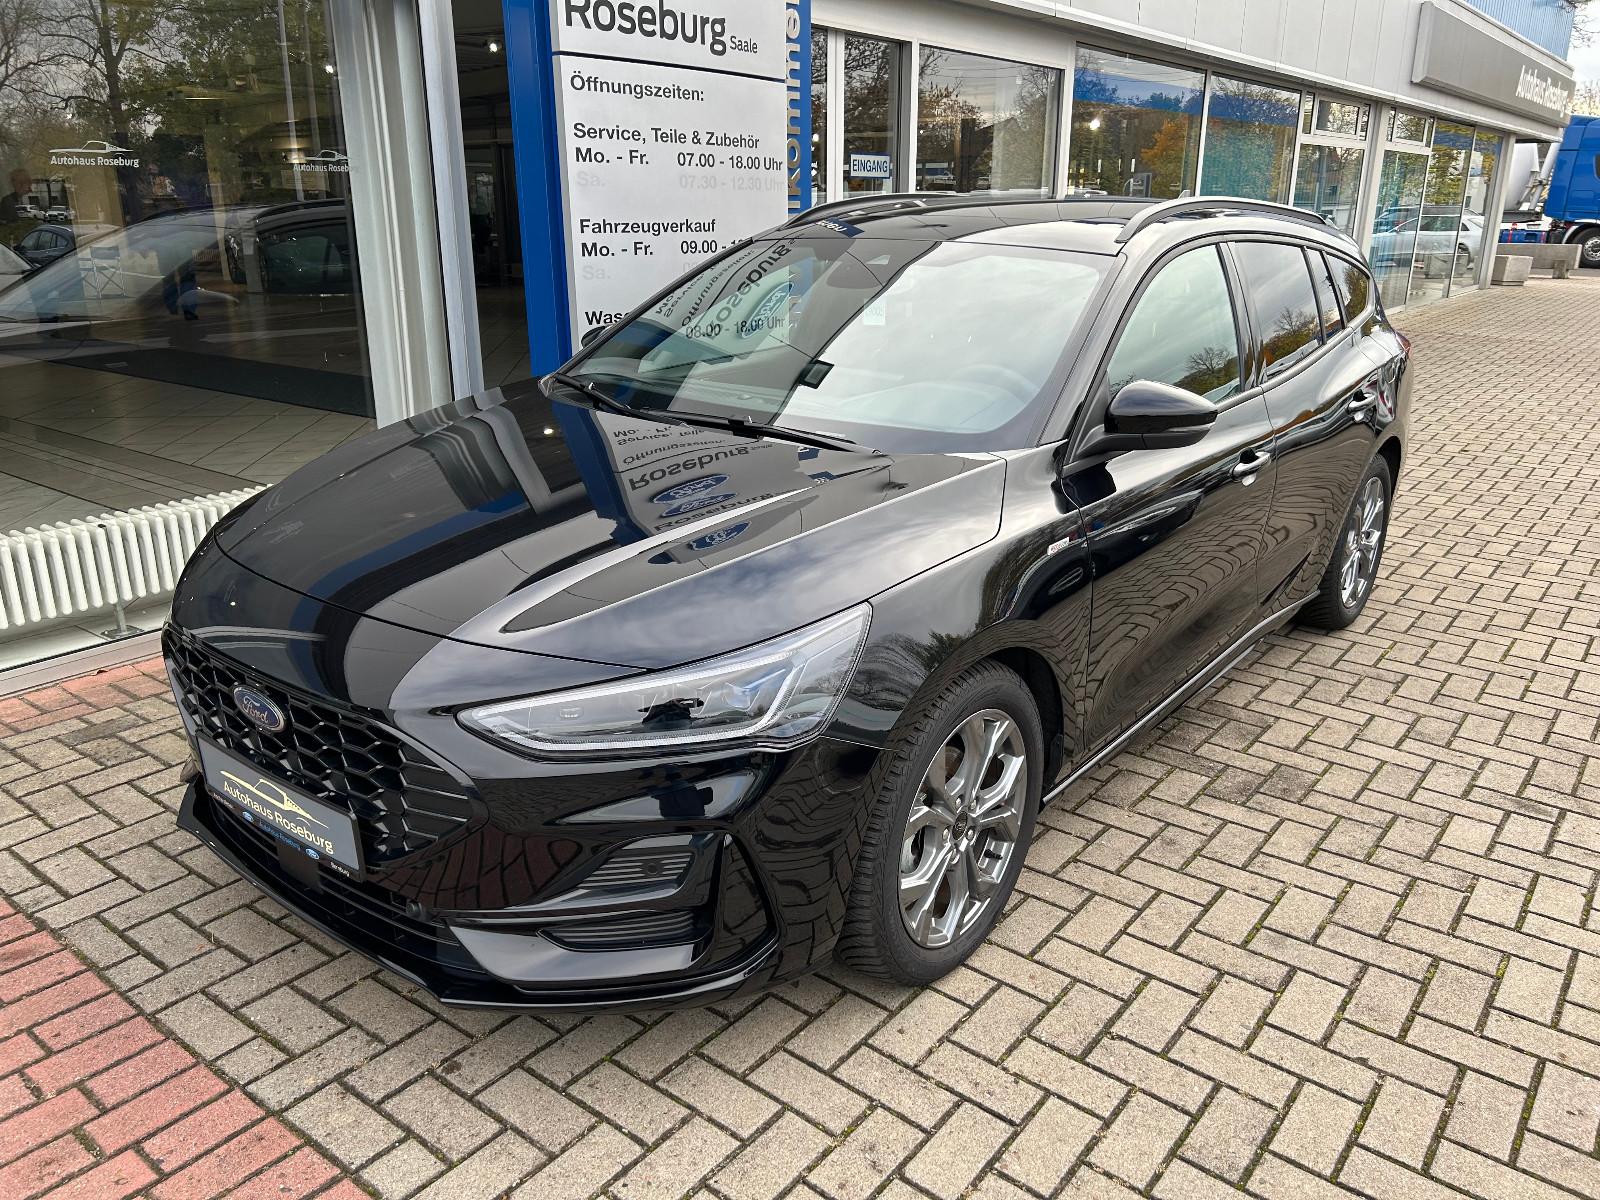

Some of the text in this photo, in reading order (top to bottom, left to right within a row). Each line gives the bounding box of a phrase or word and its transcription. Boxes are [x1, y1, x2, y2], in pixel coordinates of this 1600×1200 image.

[564, 0, 758, 56] Roseburg Saale
[570, 71, 705, 102] Öffnungszeiten:
[573, 122, 760, 149] Service, Teile & Zubehör
[50, 155, 140, 168] Autohaus Roseburg
[293, 163, 328, 172] Autohaus
[575, 147, 611, 164] Mo.
[629, 149, 649, 165] Fr.
[677, 152, 715, 167] 07.00
[729, 155, 761, 170] 18.00
[763, 157, 783, 171] Uhr
[852, 159, 888, 173] EINGANG
[579, 218, 716, 237] Fahrzeugverkauf
[581, 242, 615, 257] Mo.
[633, 241, 653, 256] Fr.
[680, 240, 717, 254] 09.00
[584, 310, 630, 326] Was
[766, 315, 786, 330] Uhr
[223, 780, 274, 820] Autohaus
[274, 811, 335, 856] Roseburg
